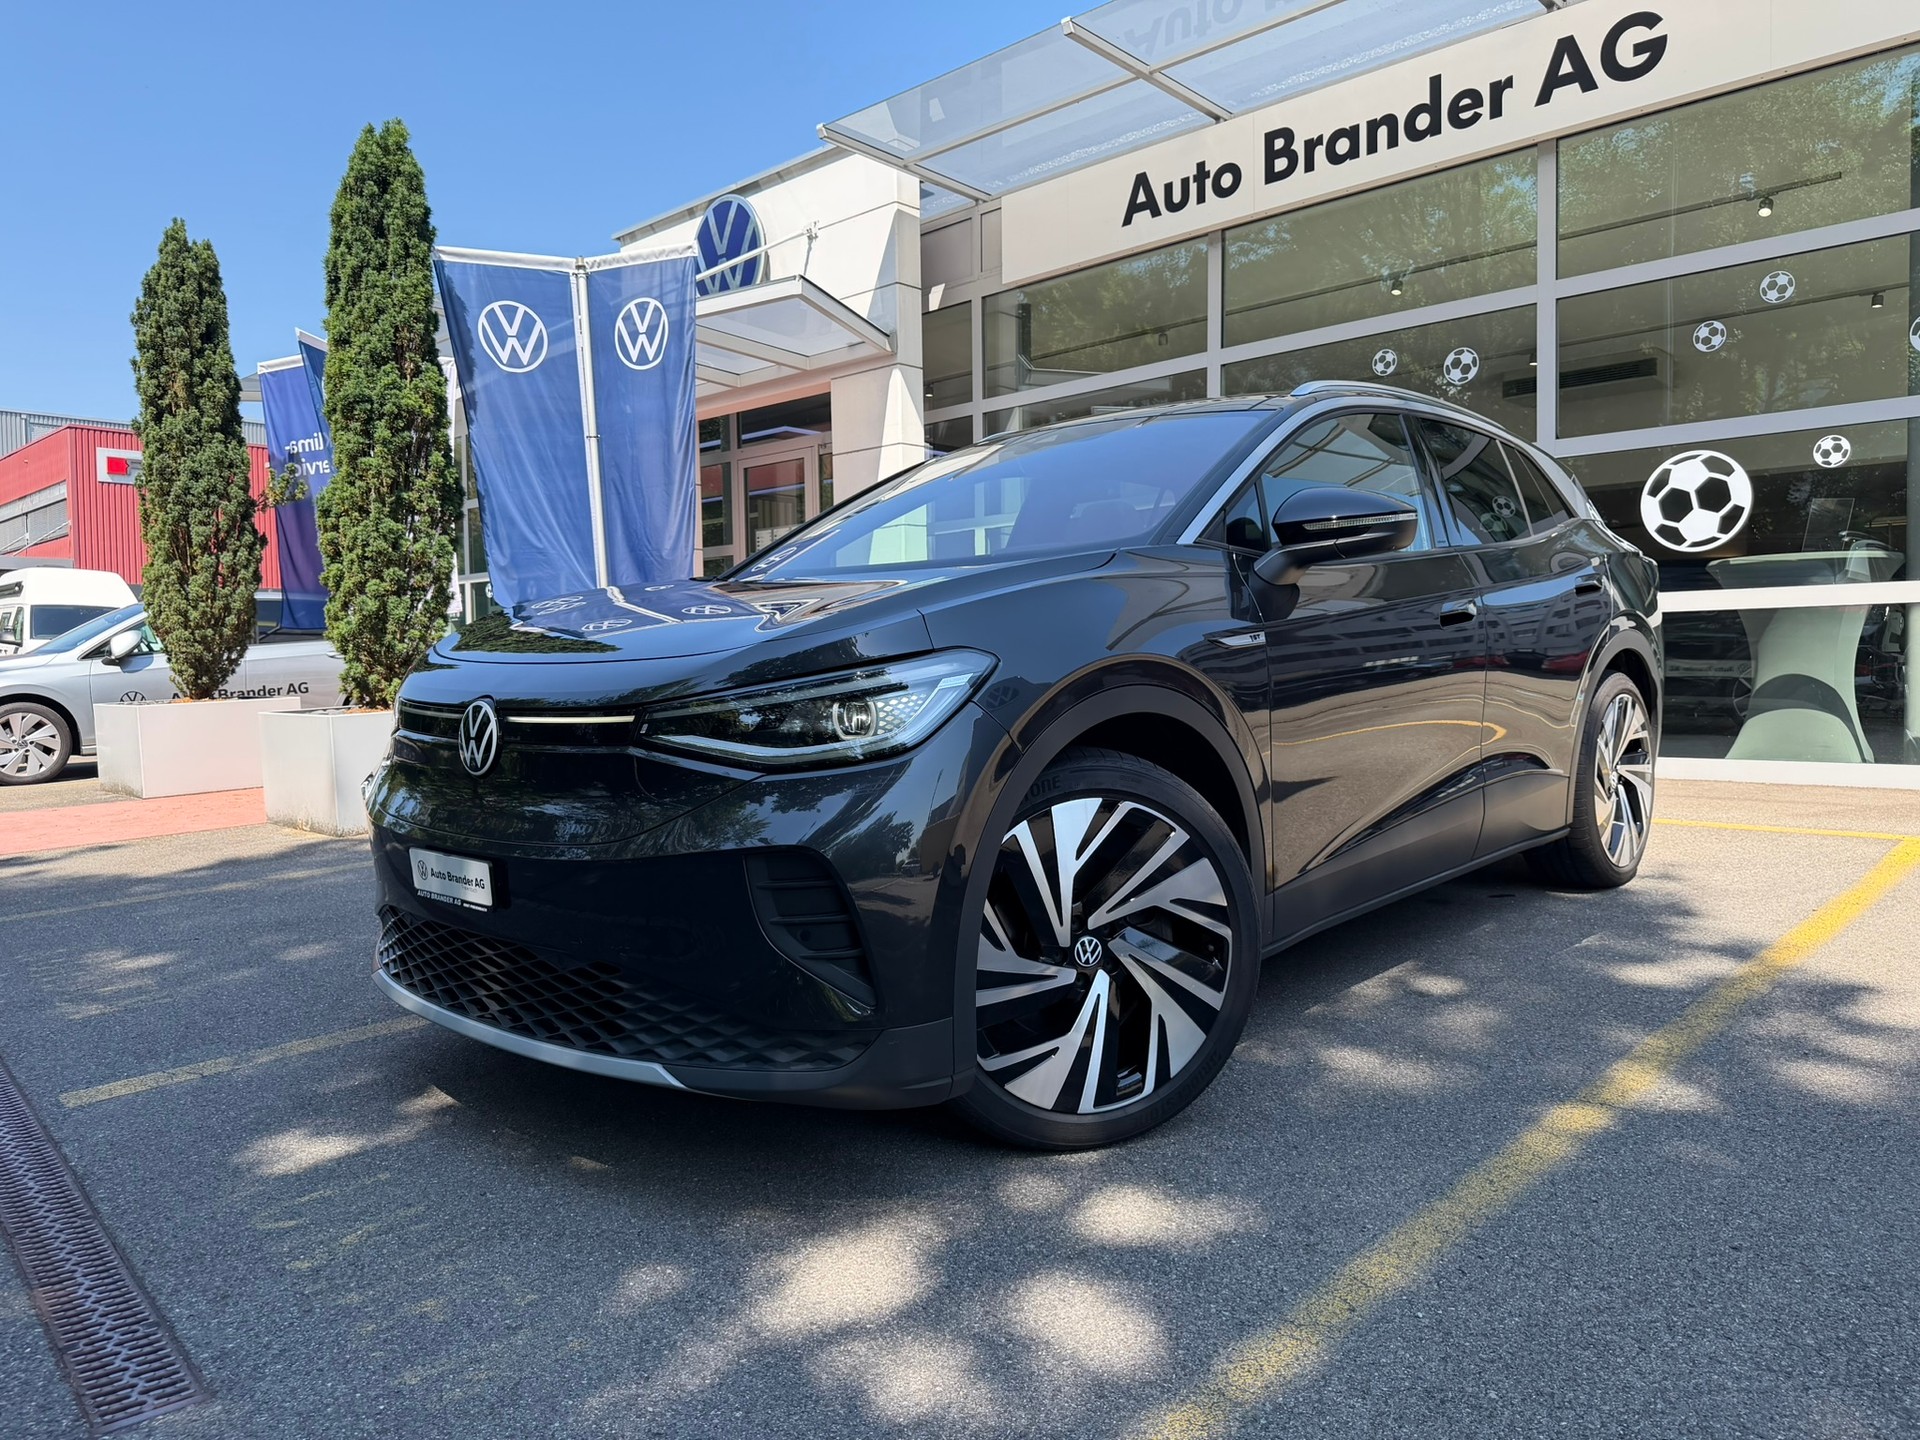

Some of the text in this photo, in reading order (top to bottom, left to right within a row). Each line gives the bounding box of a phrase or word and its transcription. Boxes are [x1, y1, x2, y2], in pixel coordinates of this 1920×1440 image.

[1122, 10, 1668, 227] Auto Brander AG
[218, 682, 309, 699] Brander AG
[431, 868, 485, 889] Auto Brander AG
[417, 890, 430, 898] AUTO
[431, 893, 454, 904] BRANDER
